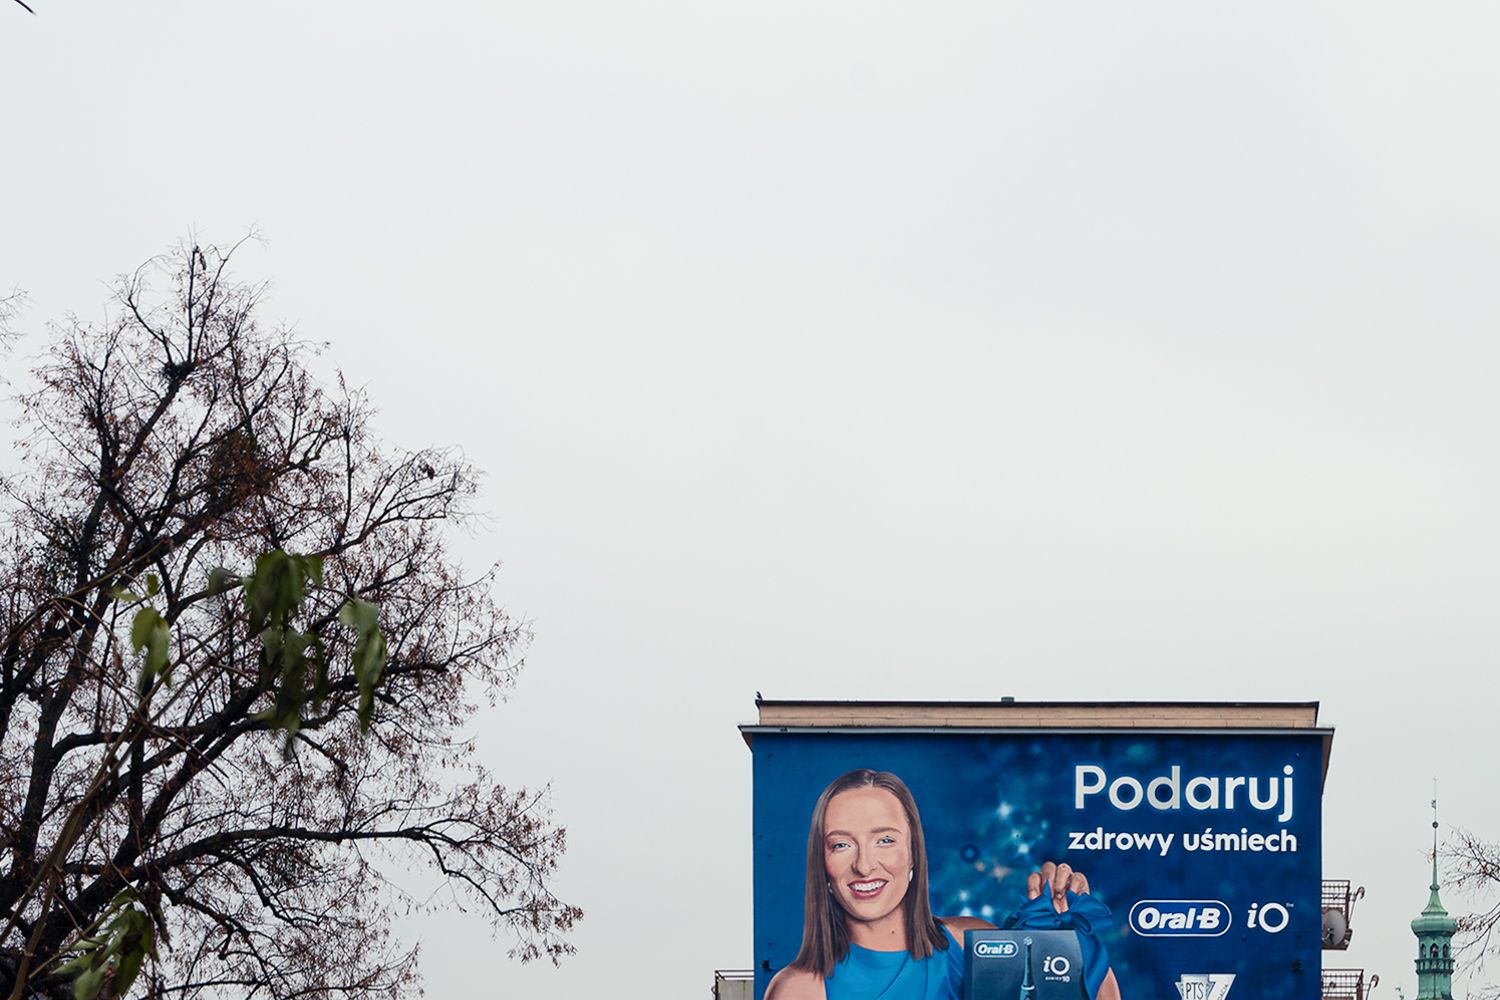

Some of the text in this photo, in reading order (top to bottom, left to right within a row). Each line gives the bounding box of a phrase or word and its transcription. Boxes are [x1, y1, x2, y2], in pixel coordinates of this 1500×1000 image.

[1075, 765, 1294, 822] Podaruj
[1068, 827, 1297, 856] zdrowy uśmiech
[1138, 907, 1221, 930] Oral-B
[977, 944, 1014, 954] Oral-B
[1185, 982, 1204, 1000] PTS
